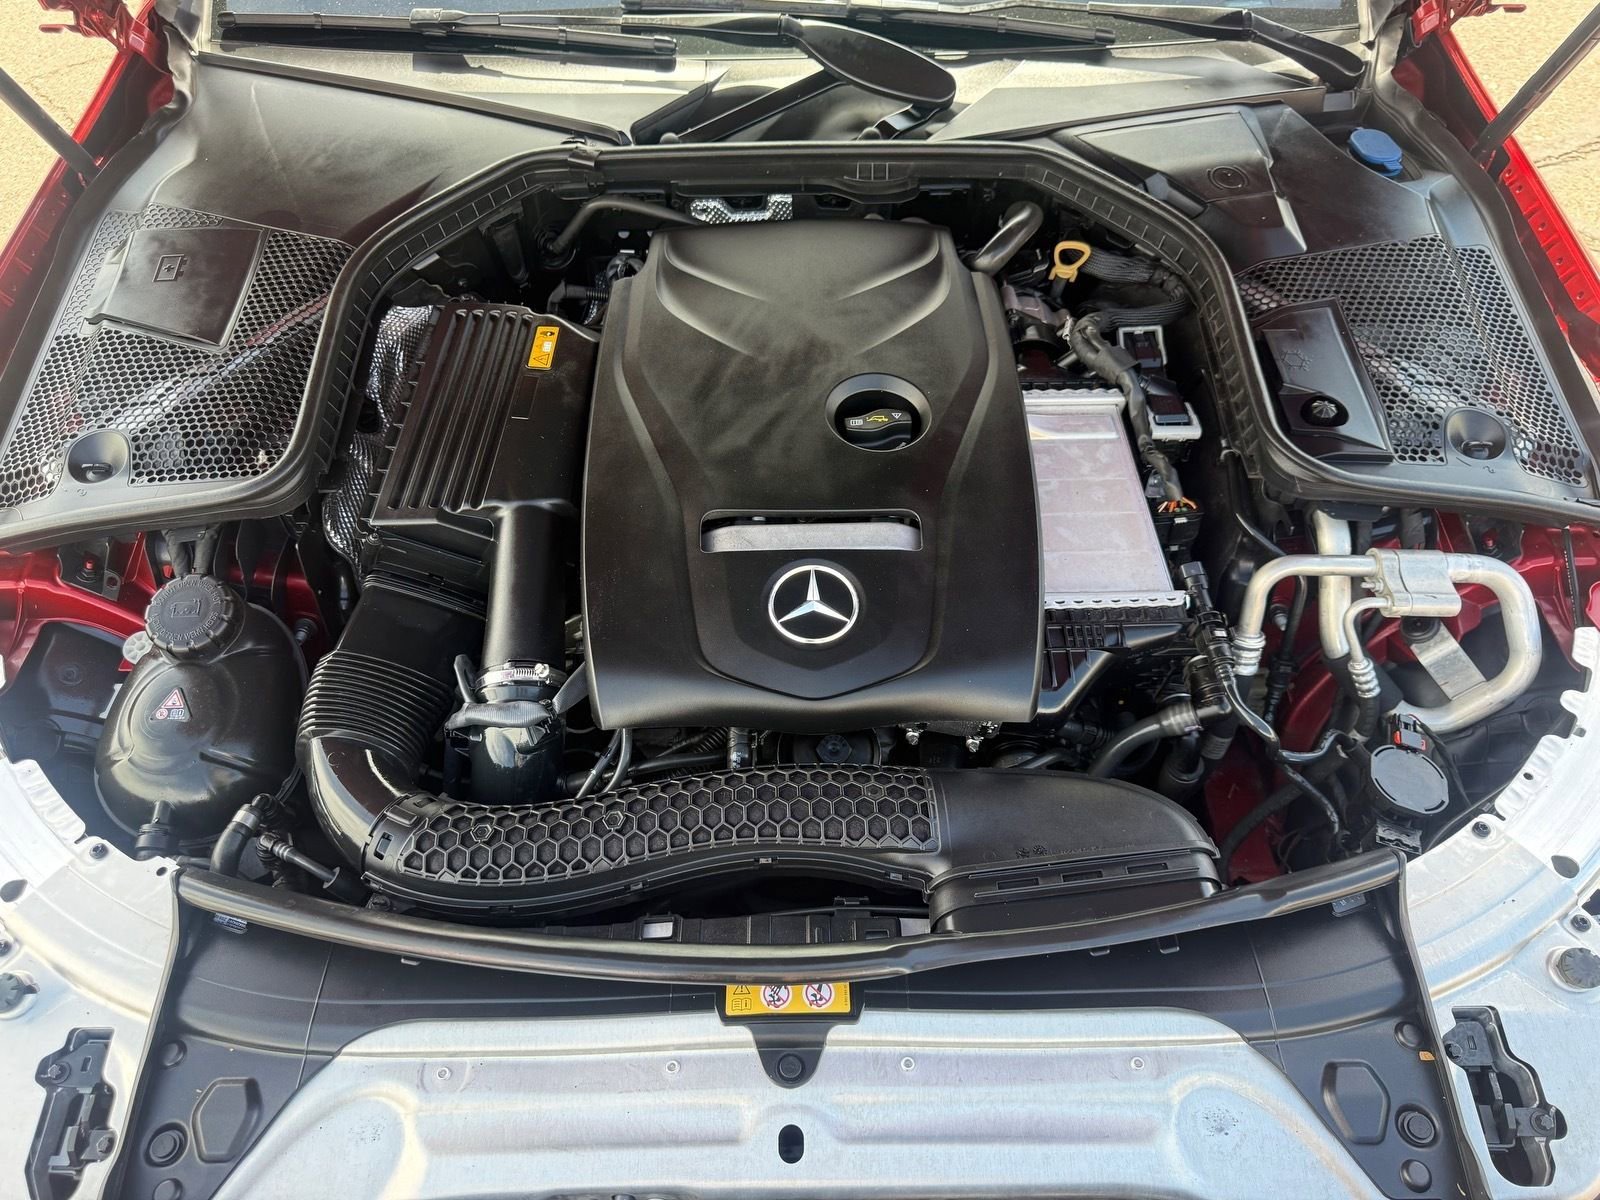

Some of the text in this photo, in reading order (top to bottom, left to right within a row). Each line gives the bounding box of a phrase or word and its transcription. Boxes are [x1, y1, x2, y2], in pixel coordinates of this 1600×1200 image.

[177, 580, 196, 588] OPEN
[184, 626, 204, 640] WENN
[204, 611, 219, 630] HEISS
